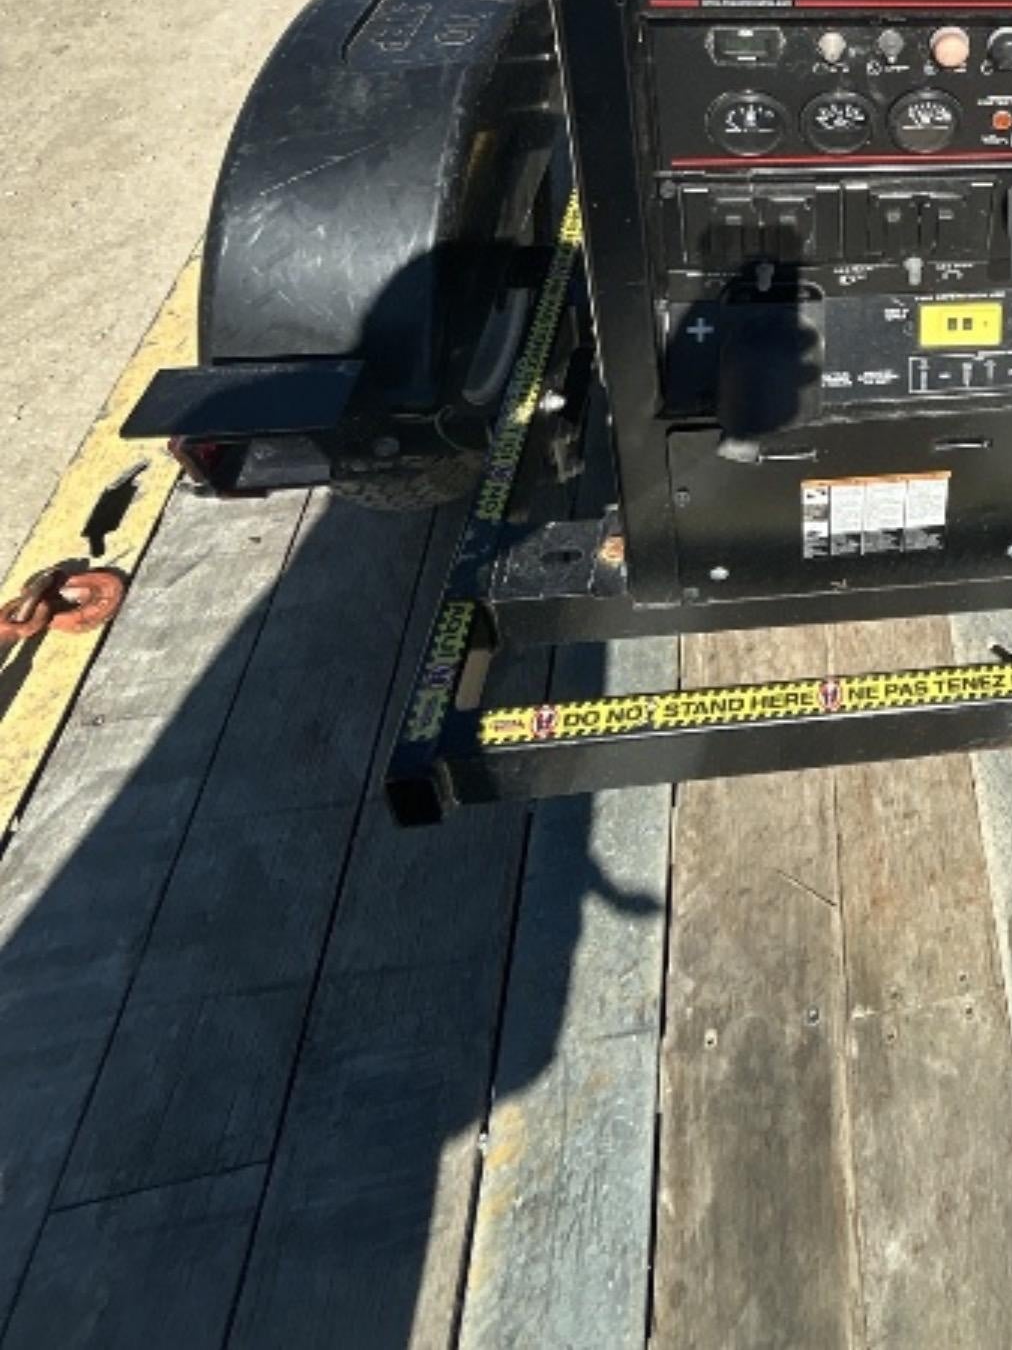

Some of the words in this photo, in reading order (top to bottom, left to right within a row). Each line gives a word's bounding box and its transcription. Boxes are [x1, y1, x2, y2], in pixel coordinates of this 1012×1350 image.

[564, 710, 600, 727] DO
[663, 697, 744, 718] STAND
[749, 691, 814, 711] HERE
[848, 686, 880, 701] NE
[884, 679, 929, 698] PAS
[932, 673, 1006, 693] TENEZ
